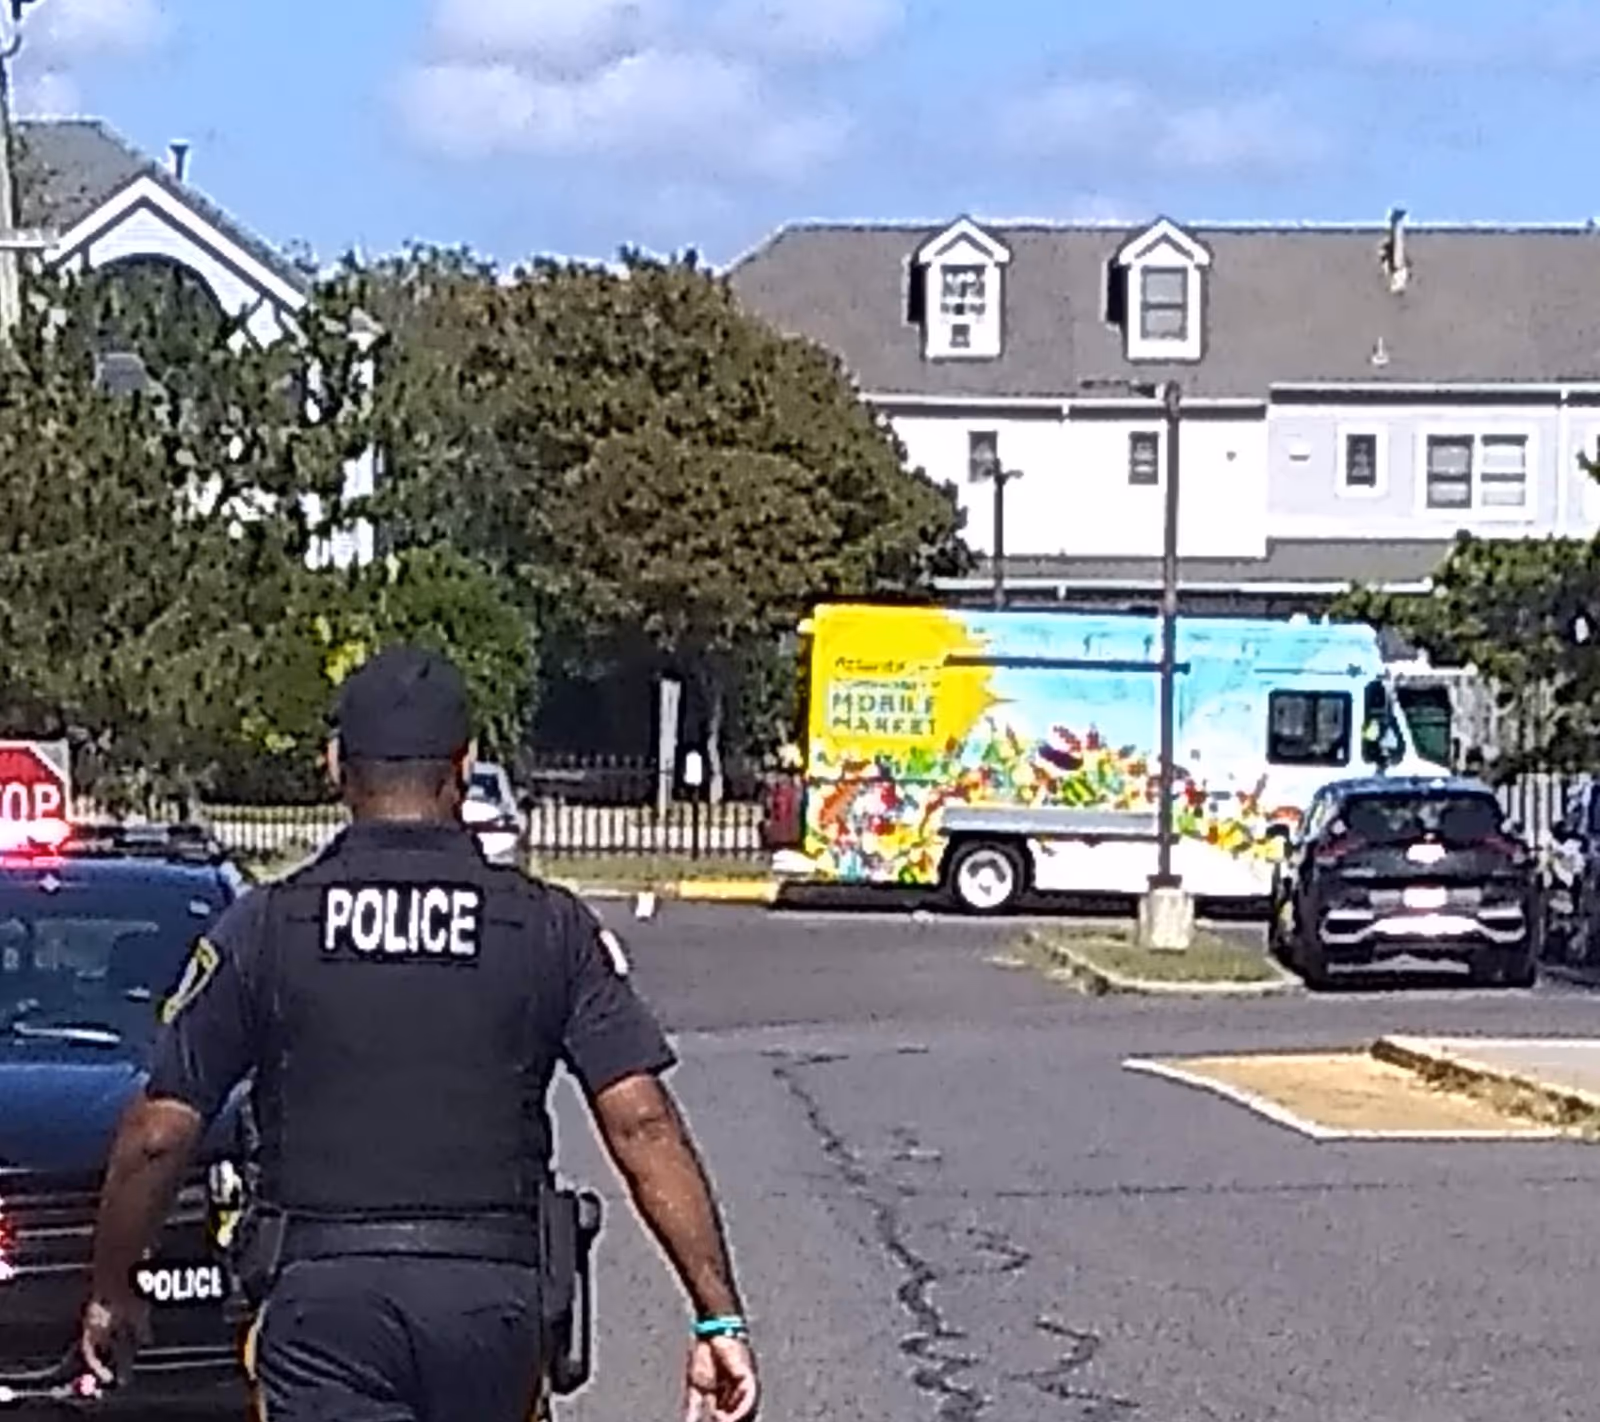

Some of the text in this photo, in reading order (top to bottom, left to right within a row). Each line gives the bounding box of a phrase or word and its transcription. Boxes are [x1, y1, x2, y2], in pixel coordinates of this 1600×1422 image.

[0, 781, 60, 821] OP
[324, 886, 480, 956] POLICE
[136, 1265, 223, 1301] POLICE
